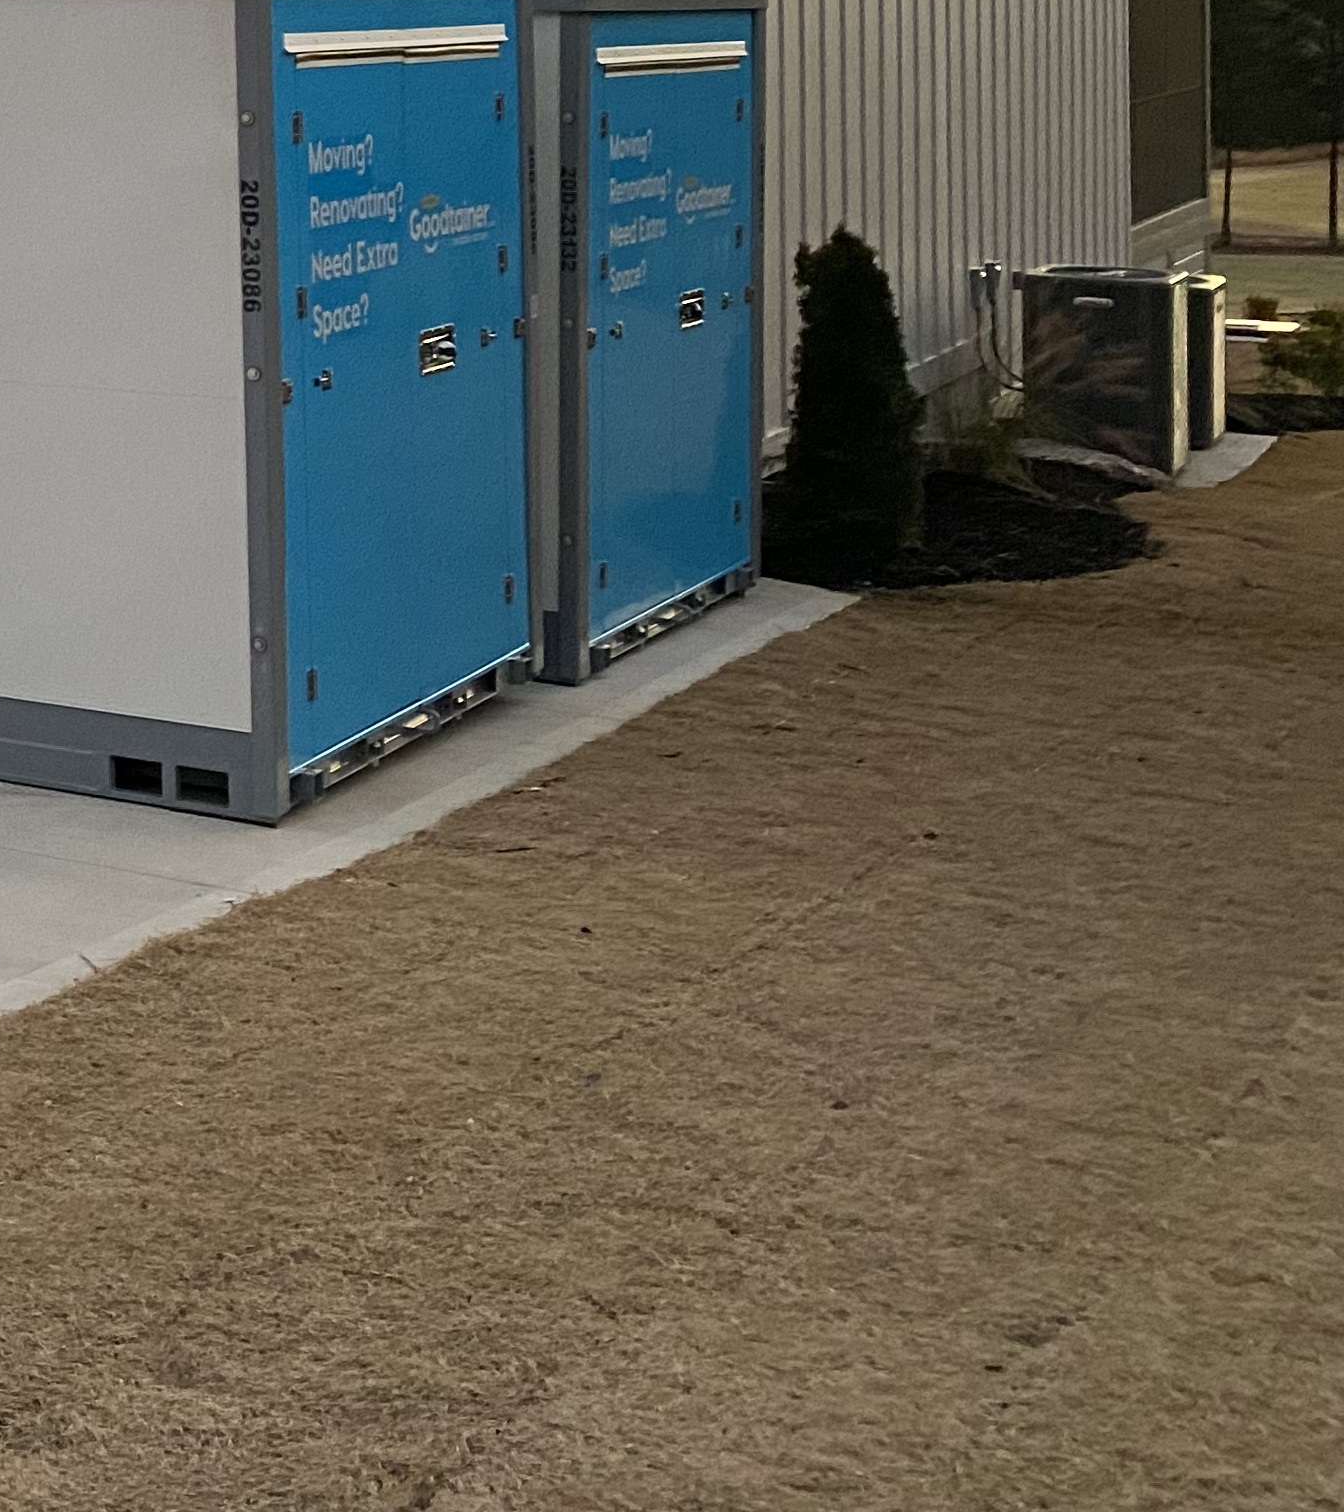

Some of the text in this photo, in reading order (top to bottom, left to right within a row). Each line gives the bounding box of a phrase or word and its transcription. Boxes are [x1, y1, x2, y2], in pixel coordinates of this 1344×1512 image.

[308, 133, 374, 175] Moving?
[309, 181, 404, 228] Renovating?
[409, 199, 490, 241] Goodtainer
[240, 179, 261, 313] 20D-23086
[311, 240, 399, 285] Need Extra
[313, 293, 370, 344] Space?
